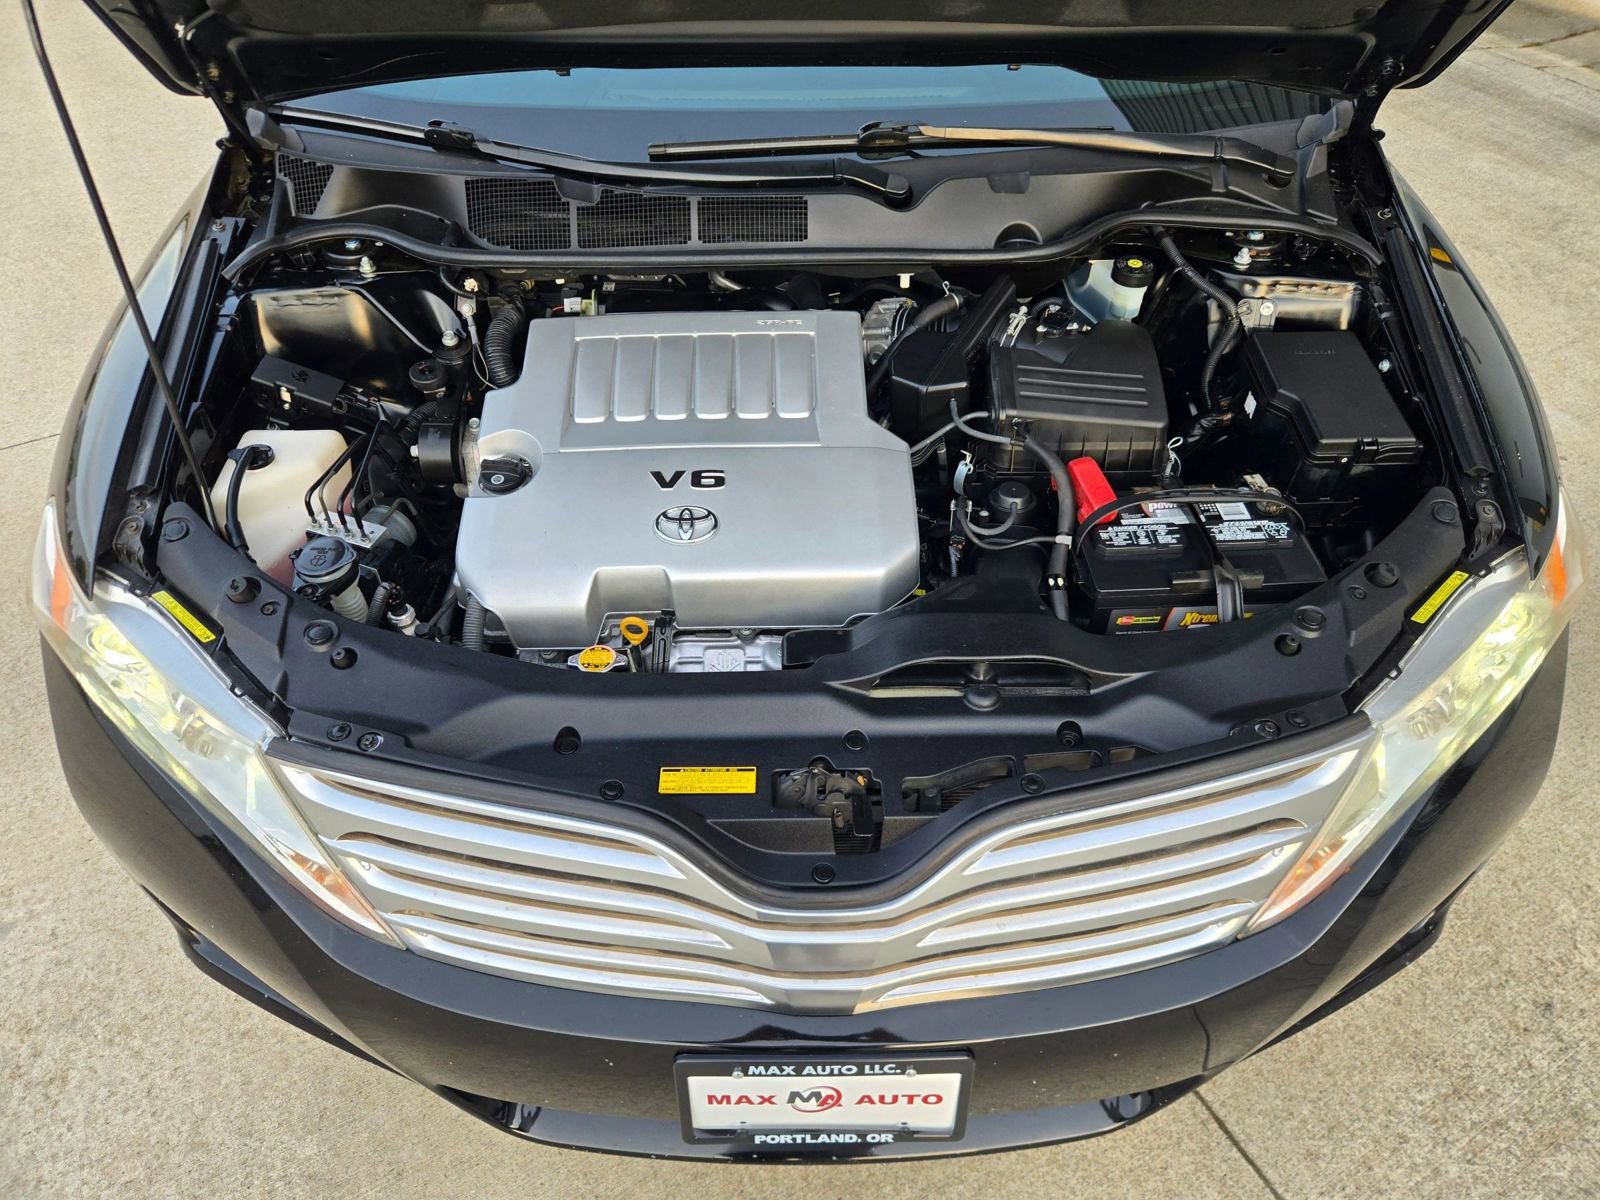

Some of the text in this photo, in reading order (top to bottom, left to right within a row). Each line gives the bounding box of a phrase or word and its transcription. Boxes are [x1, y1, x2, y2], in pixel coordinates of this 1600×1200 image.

[648, 469, 726, 489] V6
[747, 1064, 902, 1075] MAX AUTO LLC.
[707, 1094, 777, 1105] MAX
[856, 1093, 943, 1105] AUTO
[866, 1133, 895, 1143] OR
